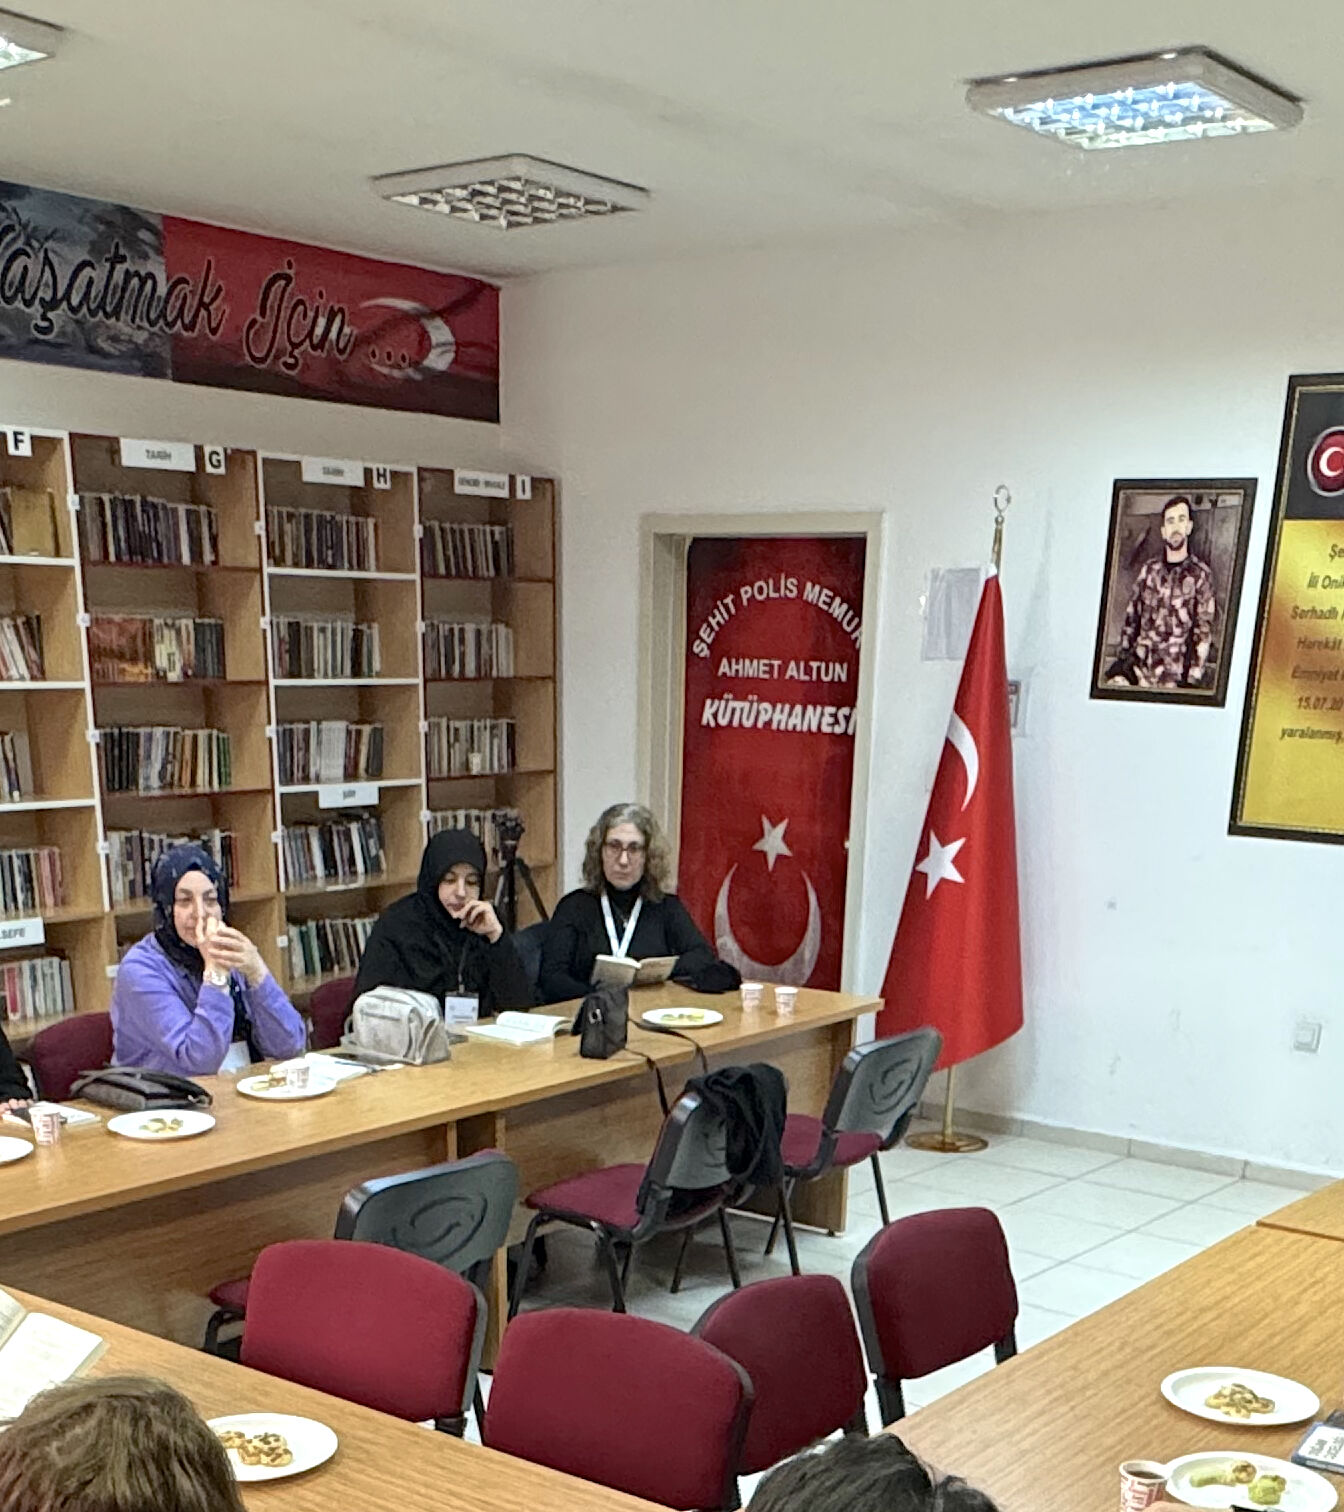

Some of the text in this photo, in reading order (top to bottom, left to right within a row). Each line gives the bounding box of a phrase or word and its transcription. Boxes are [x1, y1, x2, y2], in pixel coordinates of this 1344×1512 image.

[245, 258, 355, 370] İçin
[12, 430, 26, 451] F
[208, 450, 222, 470] G
[376, 467, 387, 486] H
[692, 593, 736, 659] ŞEHİT
[740, 573, 798, 607] POLİS
[717, 656, 848, 683] AHMET ALTUN
